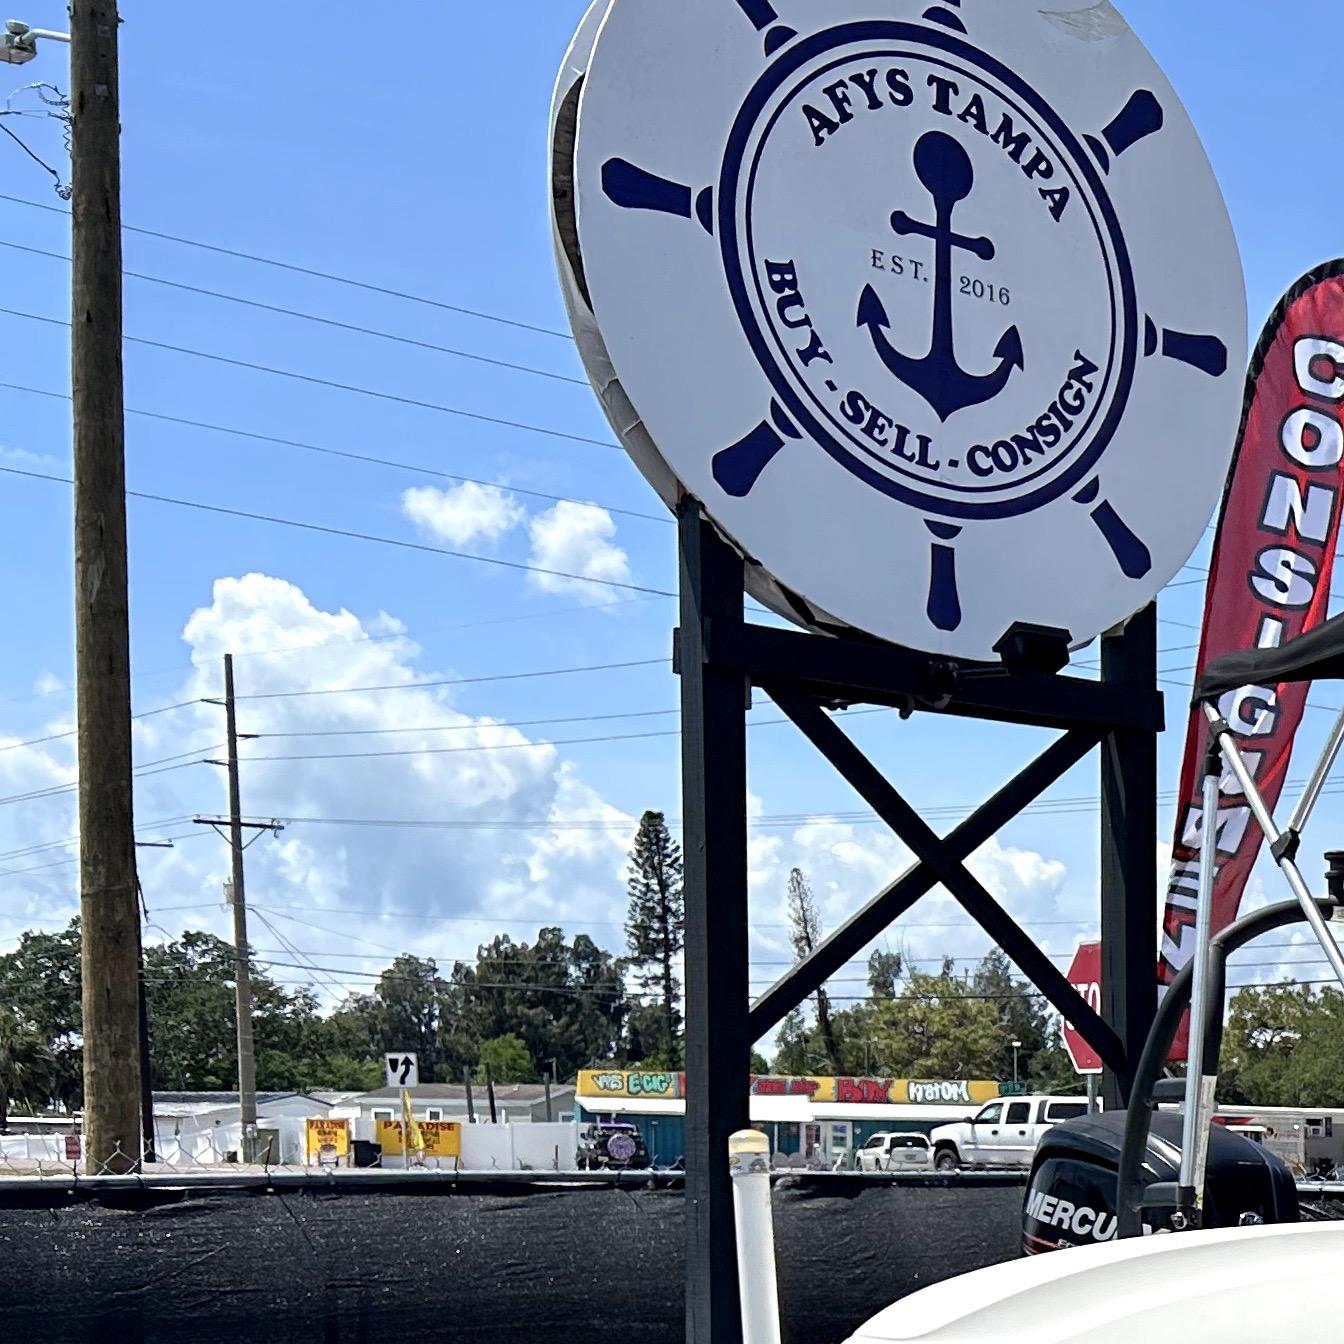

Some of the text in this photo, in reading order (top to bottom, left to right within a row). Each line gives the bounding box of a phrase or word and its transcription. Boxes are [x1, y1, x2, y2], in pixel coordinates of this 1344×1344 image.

[800, 68, 1071, 223] AFYS TAMPA
[871, 249, 1010, 306] EST. 2016
[764, 258, 832, 367] BUY
[839, 388, 940, 470] SELL
[965, 349, 1100, 477] CONSIGN
[1026, 1188, 1172, 1241] MERCU
